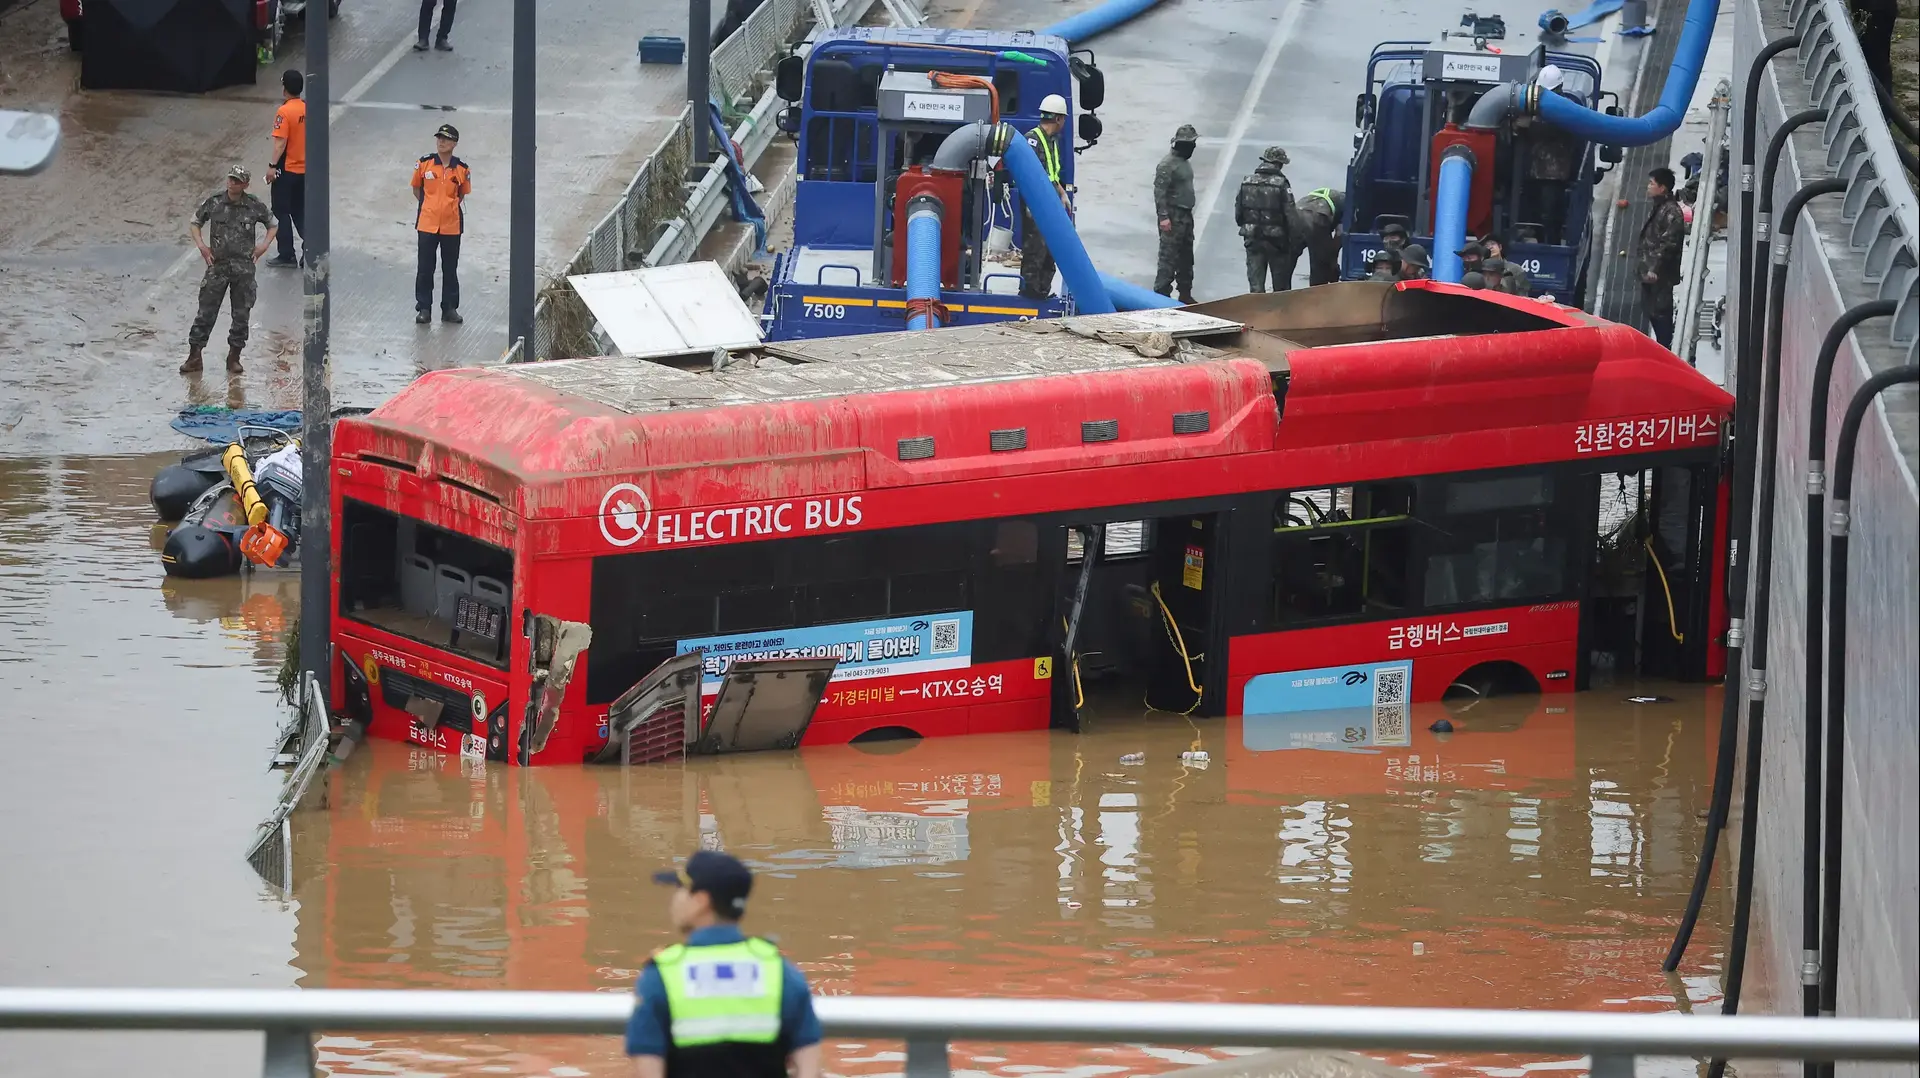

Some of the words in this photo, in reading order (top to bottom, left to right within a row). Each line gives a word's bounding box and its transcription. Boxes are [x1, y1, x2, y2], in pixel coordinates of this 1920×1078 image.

[1457, 63, 1482, 71] 대한민국
[919, 103, 946, 111] 대한민국
[803, 303, 846, 320] 7509
[1574, 414, 1717, 453] 친환경전기버스
[657, 503, 793, 545] ELECTRIC
[805, 496, 862, 530] BUS
[1388, 621, 1461, 650] 급행버스
[867, 635, 920, 661] 물어봐!
[443, 672, 472, 690] KTX오송역
[852, 667, 890, 677] 043-279-9031
[832, 686, 895, 706] 가경터미널
[922, 674, 1003, 699] KTX오송역
[473, 738, 487, 756] 주의
